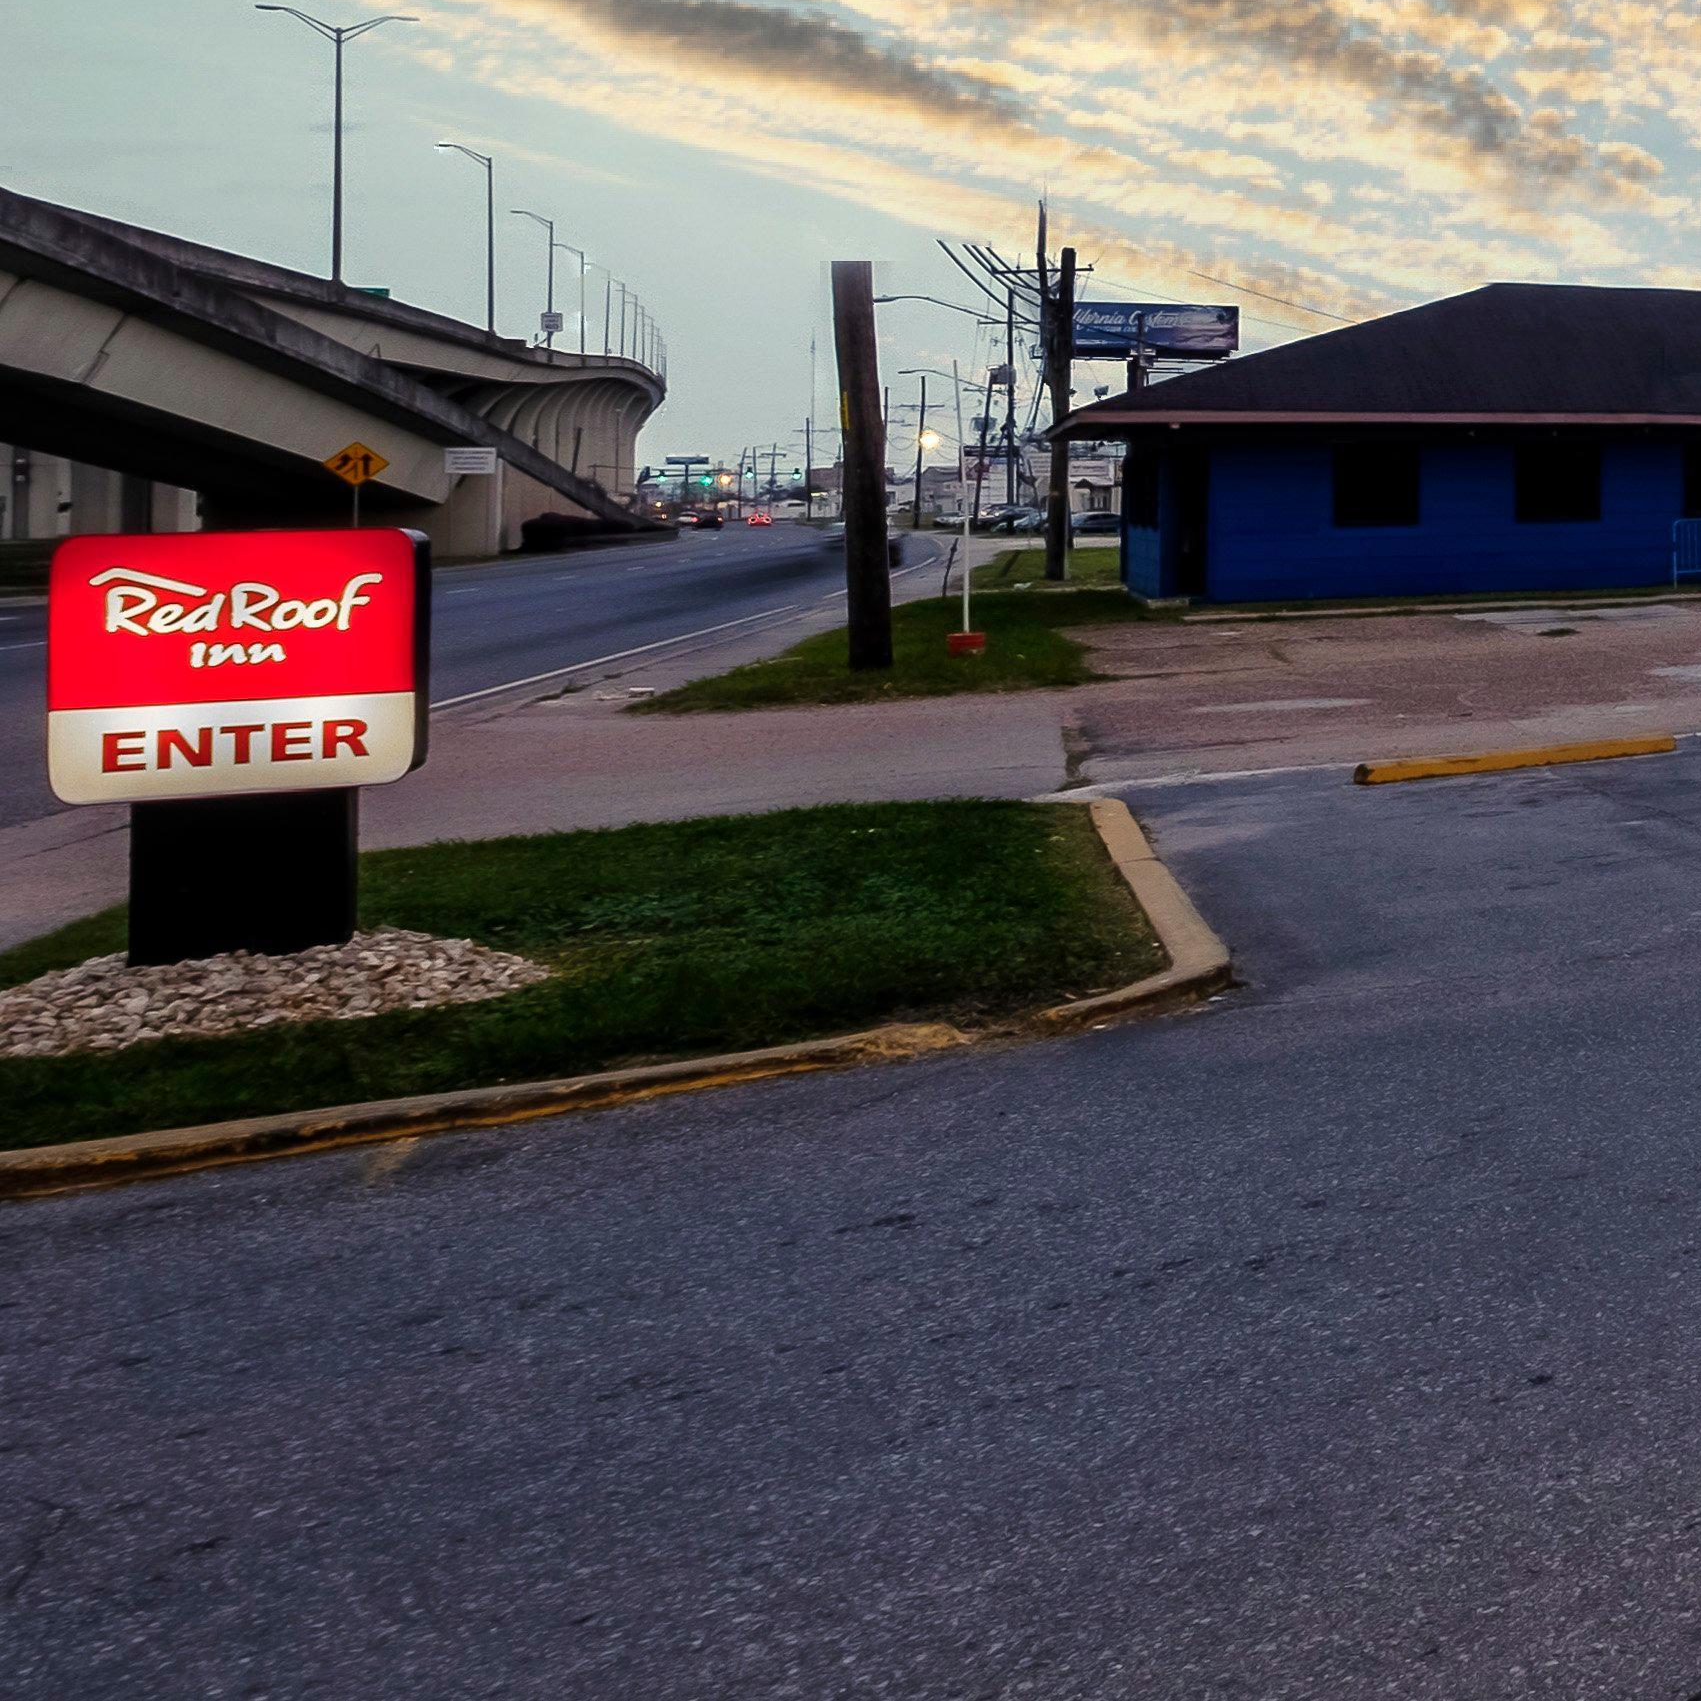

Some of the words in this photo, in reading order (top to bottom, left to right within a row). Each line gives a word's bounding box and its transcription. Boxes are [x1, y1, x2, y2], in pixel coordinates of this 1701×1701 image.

[105, 585, 226, 637] Red
[230, 572, 383, 632] Roof
[101, 718, 370, 774] ENTER
